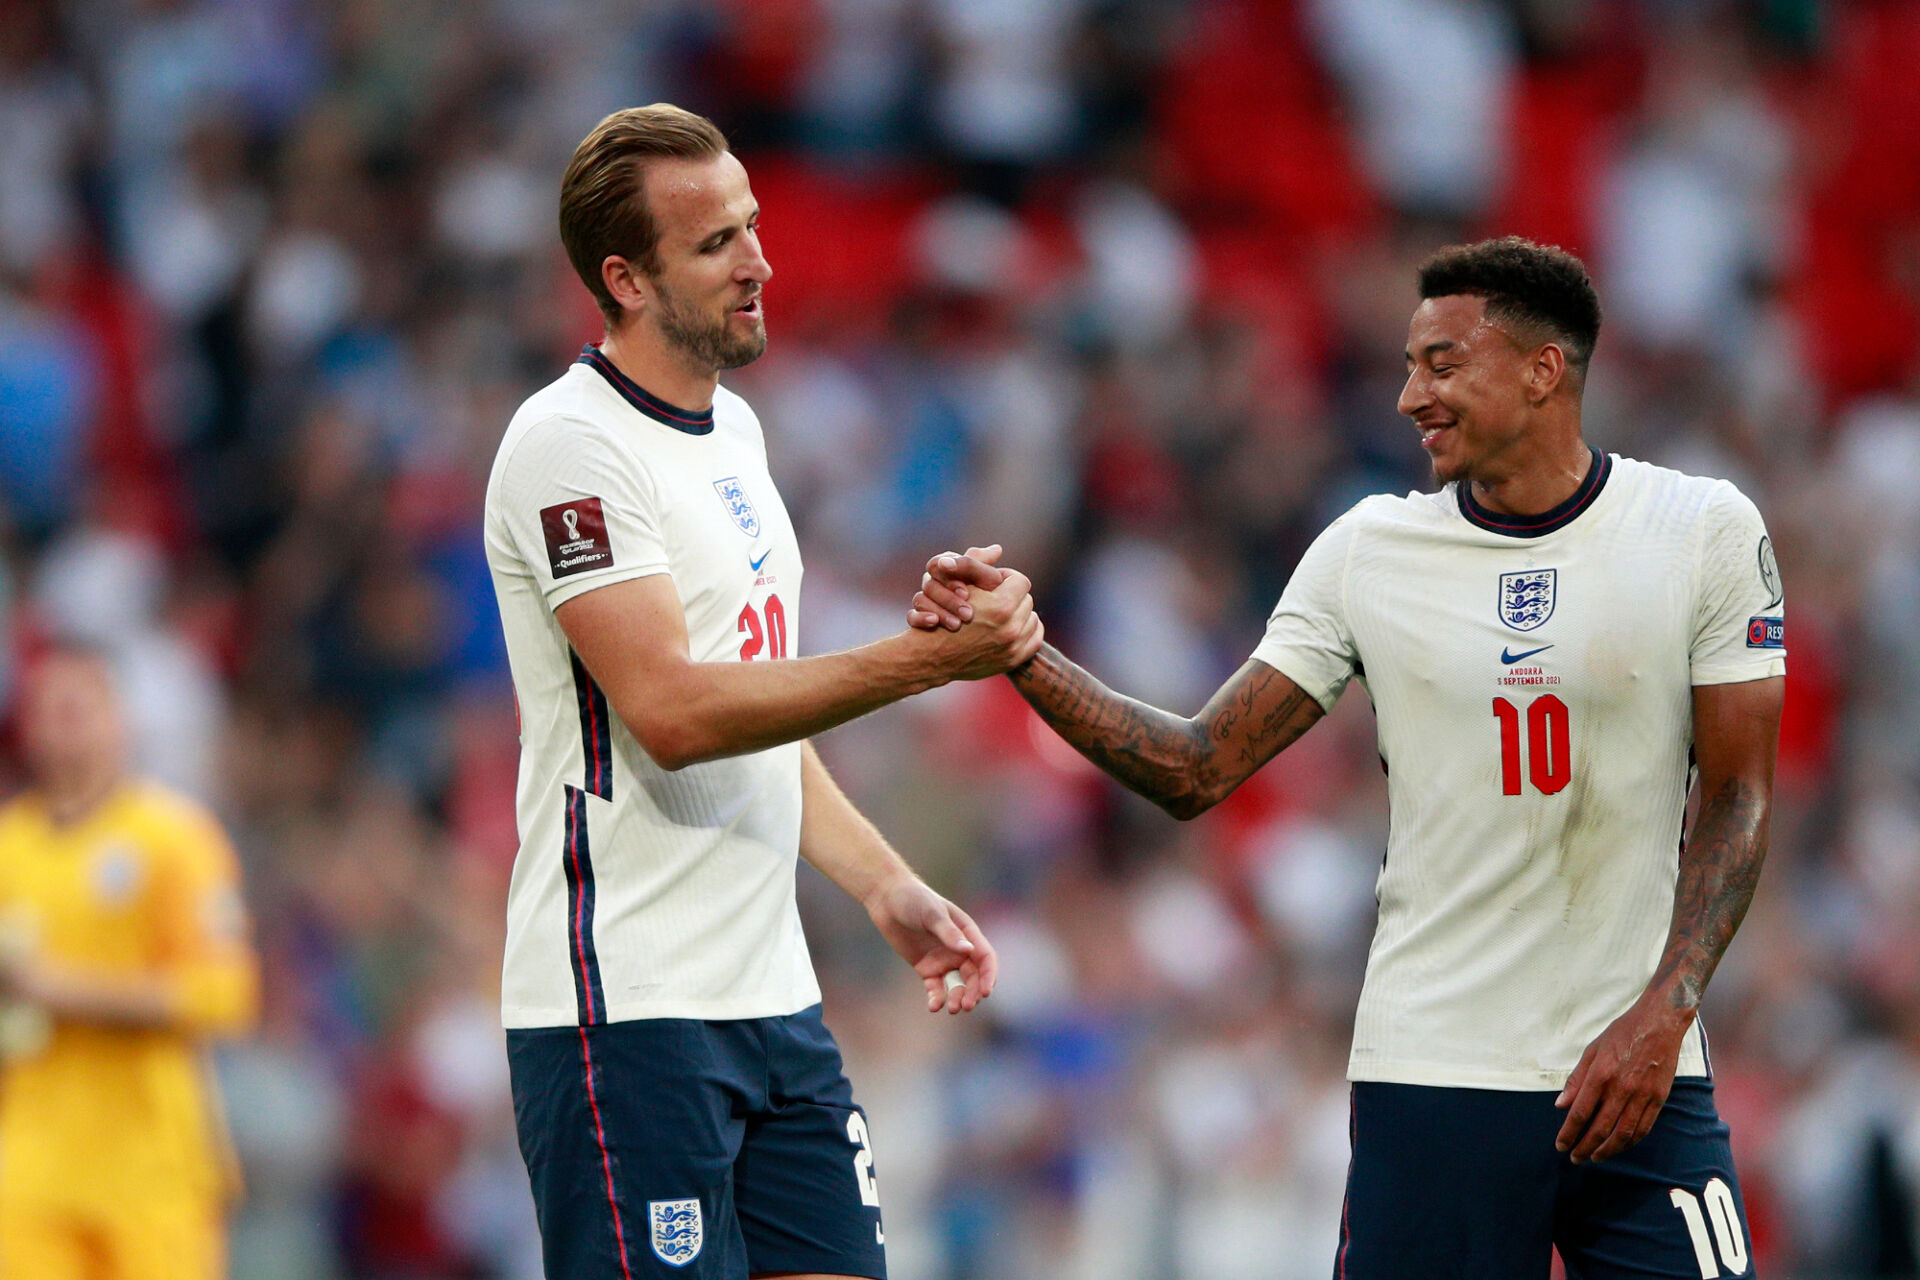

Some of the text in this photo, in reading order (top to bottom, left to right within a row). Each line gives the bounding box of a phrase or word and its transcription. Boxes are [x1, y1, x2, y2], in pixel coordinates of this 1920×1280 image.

[560, 553, 601, 568] Qualifiers
[737, 593, 787, 661] 20
[1503, 677, 1544, 686] SEPTEMBER
[1545, 676, 1561, 685] 2021
[1509, 667, 1543, 676] ANDORRA
[1492, 693, 1571, 796] 10
[1668, 1177, 1748, 1280] 10
